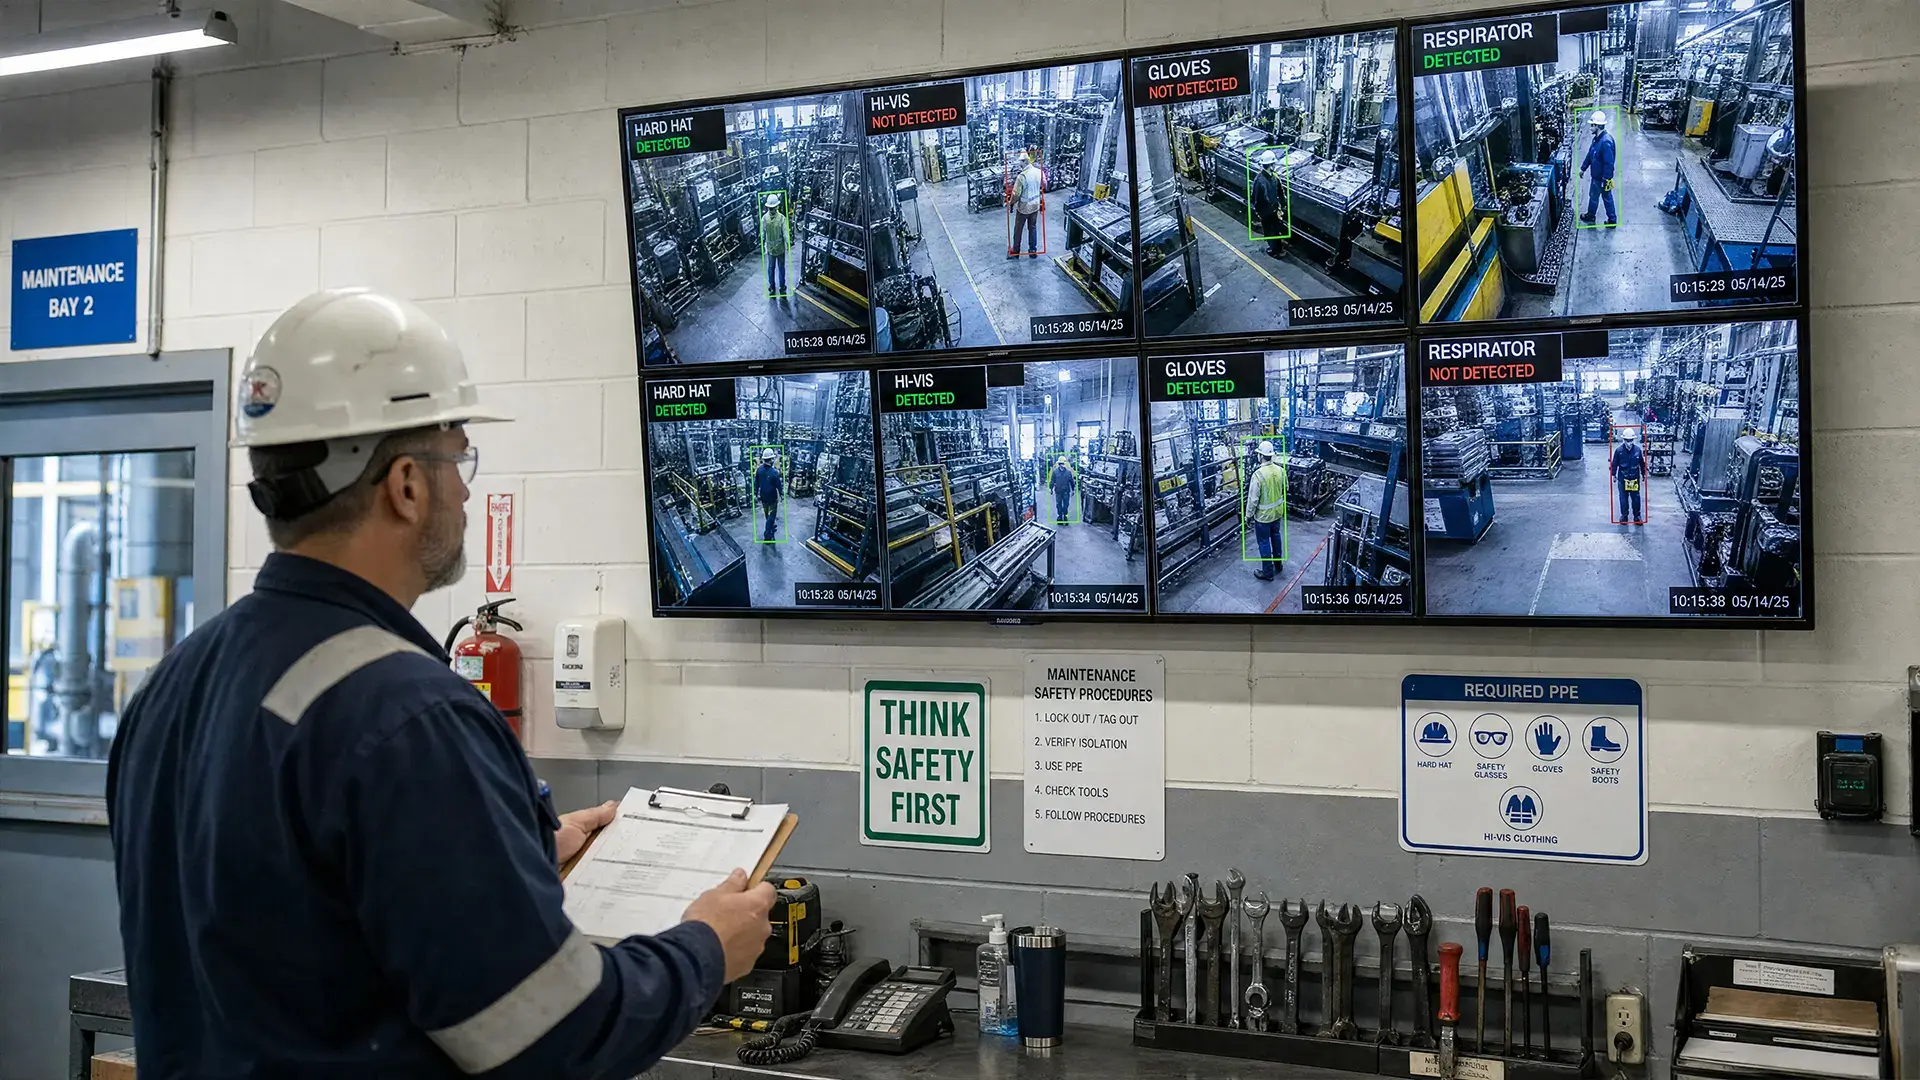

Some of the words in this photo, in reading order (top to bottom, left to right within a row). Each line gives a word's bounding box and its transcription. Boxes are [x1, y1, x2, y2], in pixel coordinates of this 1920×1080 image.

[1423, 22, 1533, 49] RESPIRATOR
[1424, 48, 1500, 69] DETECTED
[1148, 59, 1211, 80] GLOVES
[1149, 84, 1174, 99] NOT
[1177, 77, 1238, 96] DETECTED
[871, 93, 910, 111] HI-VIS
[872, 114, 896, 128] NOT
[899, 107, 957, 126] DETECTED
[634, 121, 667, 137] HARD
[671, 117, 693, 132] HAT
[636, 136, 691, 153] DETECTED
[22, 262, 124, 289] MAINTENANCE
[1731, 276, 1786, 290] 05/14/25
[49, 296, 79, 318] BAY
[83, 295, 93, 315] 2
[1344, 302, 1393, 316] 05/14/25
[1033, 322, 1074, 334] 10:15:28
[1079, 319, 1123, 332] 05/14/25
[786, 336, 823, 348] 10:15:28
[827, 334, 866, 346] 05/14/25
[1429, 340, 1536, 360] RESPIRATOR
[1165, 360, 1226, 377] GLOVES
[1430, 367, 1459, 381] NOT
[1463, 364, 1535, 380] DETECTED
[895, 373, 934, 388] HI-VIS
[1167, 380, 1235, 395] DETECTED
[654, 385, 685, 399] HARD
[689, 384, 712, 398] HAT
[896, 392, 955, 406] DETECTED
[655, 403, 707, 417] DETECTED
[797, 589, 834, 600] 10:15:28
[838, 590, 877, 600] 05/14/25
[1050, 592, 1090, 603] 10:15:34
[1095, 592, 1139, 604] 05/14/25
[1304, 593, 1349, 604] 10:15:36
[1354, 593, 1403, 605] 05/14/25
[1672, 595, 1725, 607] 10:15:38
[1732, 595, 1790, 608] 05/14/25
[1048, 668, 1136, 682] MAINTENANCE
[1034, 686, 1076, 700] SAFETY
[1079, 688, 1153, 702] PROCEDURES
[1465, 683, 1544, 698] REQUIRED
[1550, 685, 1579, 699] PPE
[880, 699, 970, 737] THINK
[1035, 713, 1042, 722] 1.
[1045, 713, 1069, 723] LOCK
[1071, 713, 1090, 723] OUT
[1092, 714, 1097, 724] /
[1099, 714, 1116, 724] TAG
[1119, 715, 1139, 725] OUT
[1035, 736, 1042, 746] 2.
[1045, 737, 1076, 747] VERIFY
[1079, 738, 1127, 749] ISOLATION
[876, 746, 974, 782] SAFETY
[1035, 760, 1042, 770] 3.
[1045, 761, 1063, 771] USE
[1066, 761, 1083, 772] PPE
[1532, 765, 1563, 773] GLOVES
[1591, 767, 1620, 775] SAFETY
[1474, 771, 1508, 779] GLASSES
[1592, 776, 1619, 784] BOOTS
[1034, 785, 1042, 794] 4.
[1045, 785, 1076, 796] CHECK
[1078, 787, 1109, 798] TOOLS
[892, 791, 960, 825] FIRST
[1035, 809, 1043, 819] 5.
[1045, 810, 1082, 821] FOLLOW
[1084, 811, 1146, 824] PROCEDURES
[1484, 833, 1511, 842] HI-VIS
[1513, 834, 1558, 844] CLOTHING
